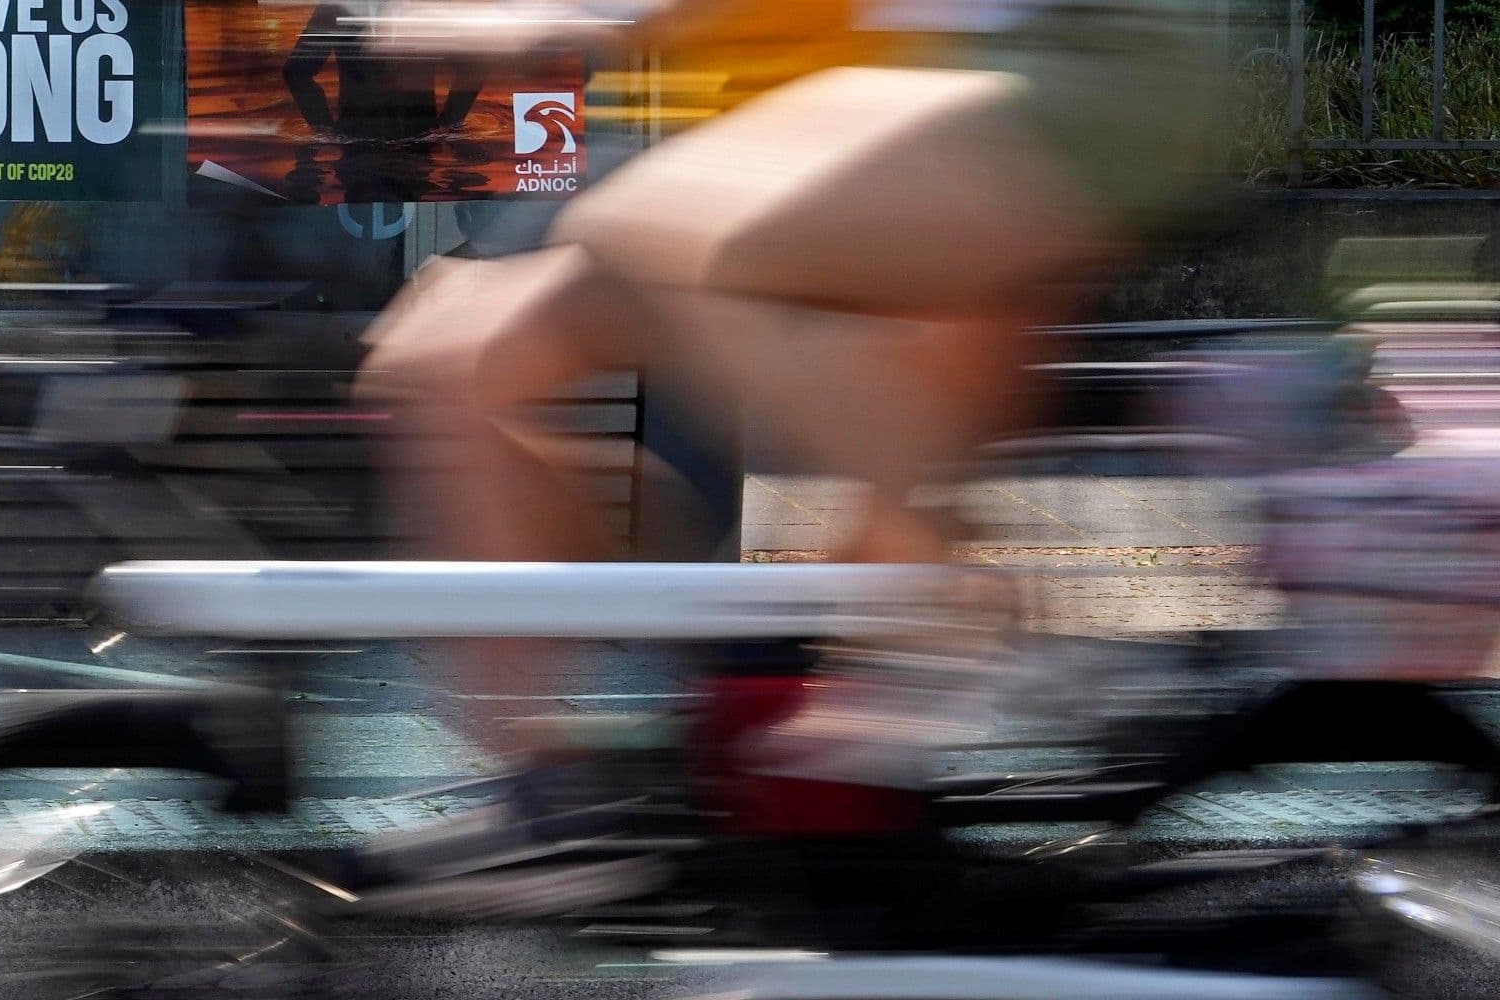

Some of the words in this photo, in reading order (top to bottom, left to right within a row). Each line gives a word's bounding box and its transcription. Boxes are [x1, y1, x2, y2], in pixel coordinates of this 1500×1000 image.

[7, 163, 25, 181] OF
[28, 163, 74, 182] COP28
[516, 178, 577, 192] ADNOC
